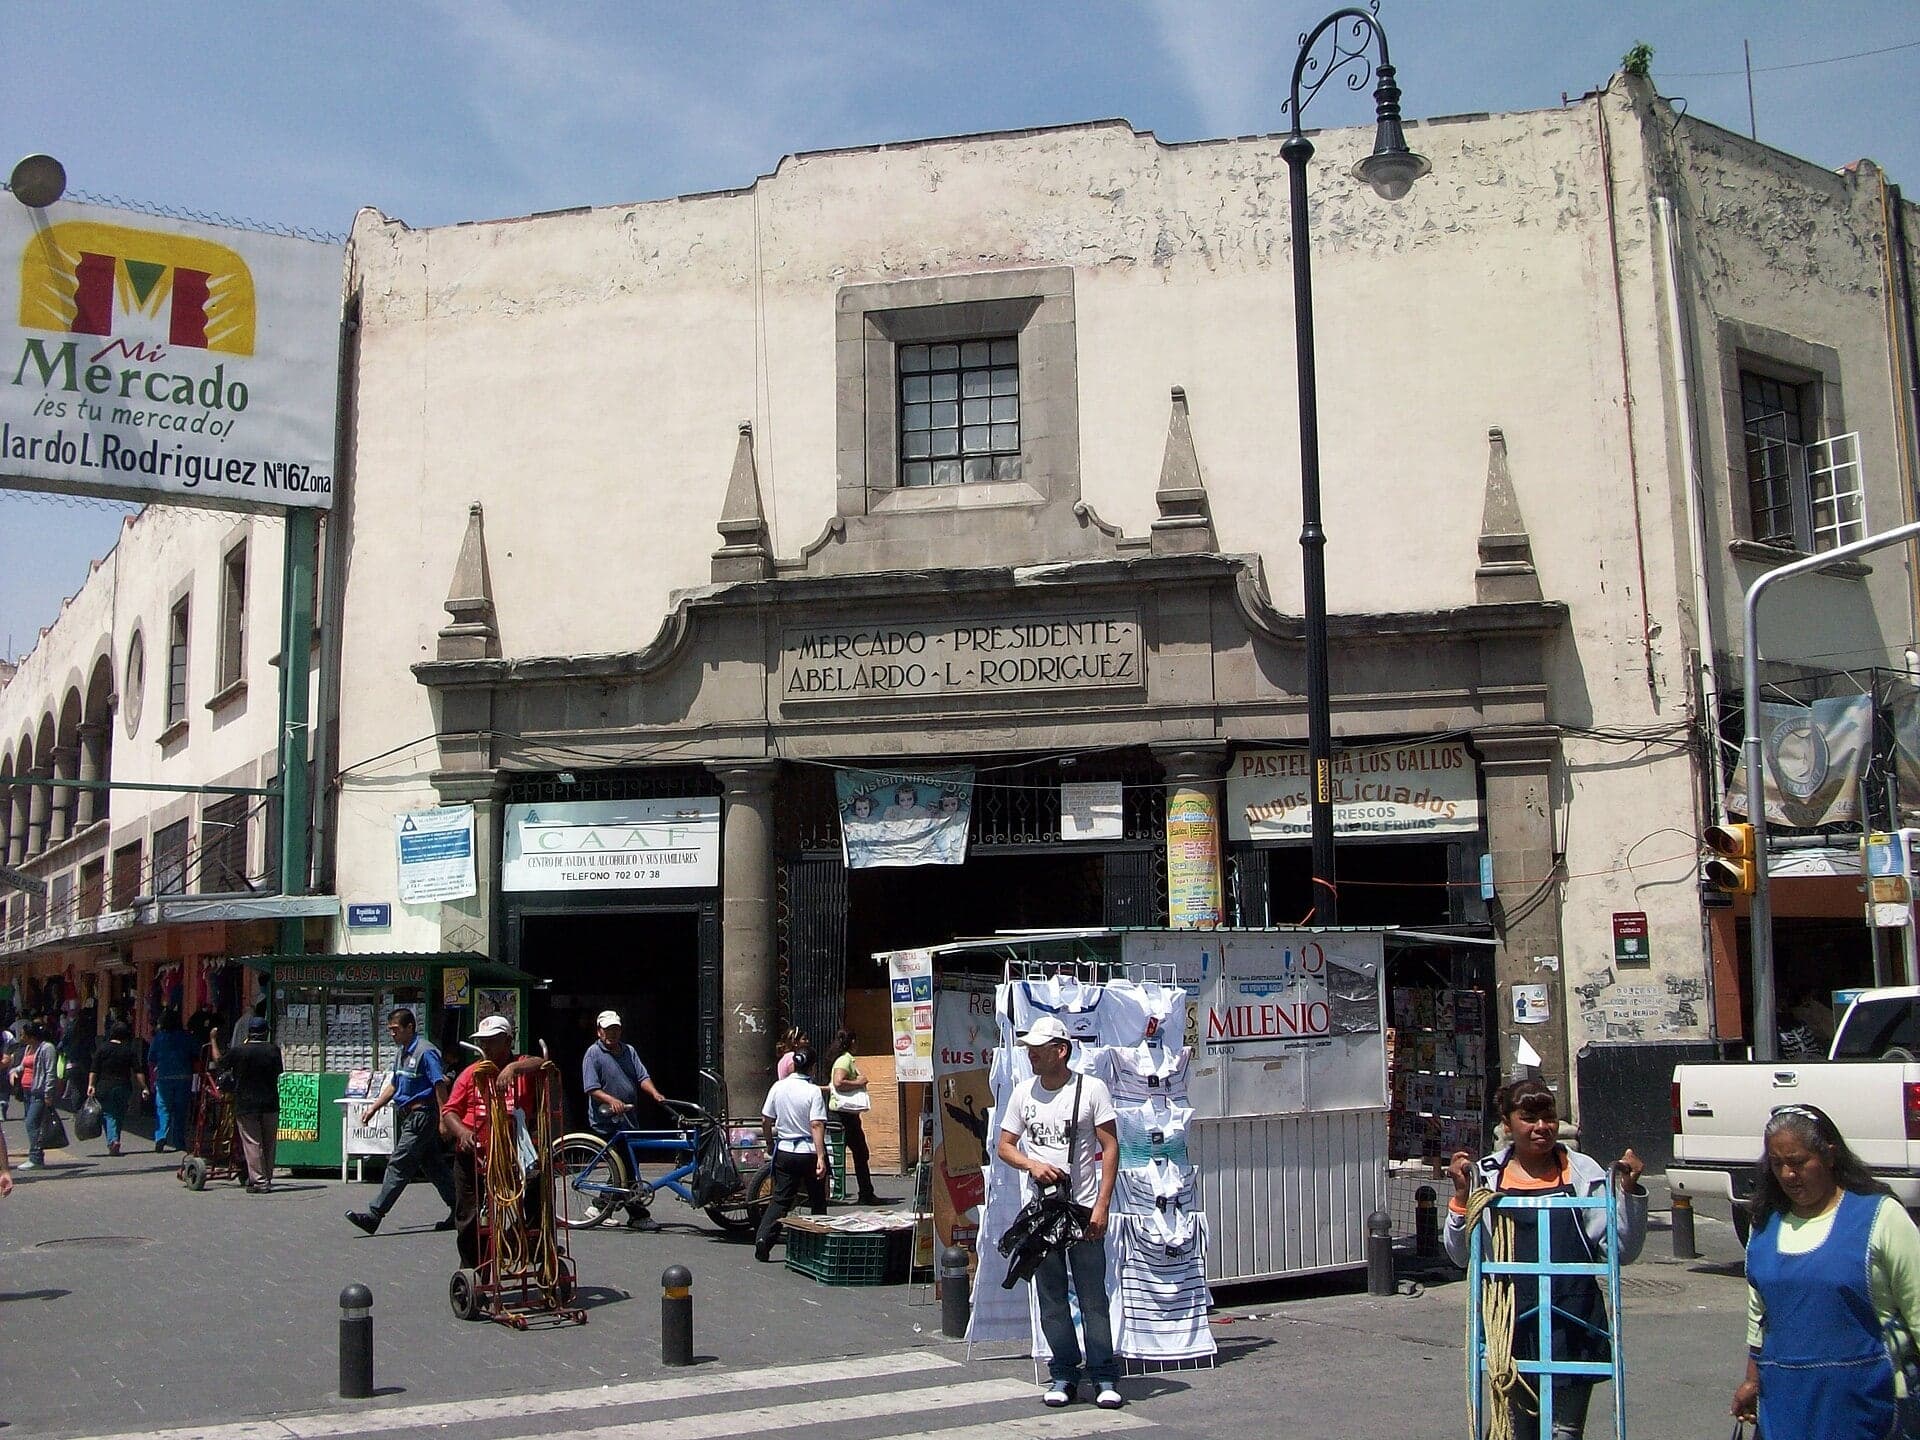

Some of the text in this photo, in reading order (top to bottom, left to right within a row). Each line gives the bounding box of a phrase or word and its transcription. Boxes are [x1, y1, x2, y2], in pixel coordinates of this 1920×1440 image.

[90, 338, 168, 363] Mi
[11, 338, 250, 413] Mercado
[77, 398, 102, 422] tu
[111, 407, 235, 443] mercado!
[102, 433, 257, 487] Rodriguez
[799, 619, 1121, 660] MERCADO PRESIDENTE
[788, 652, 1134, 692] ABELARDO L RODRIGUEZ
[1360, 751, 1391, 773] LOS
[1397, 747, 1463, 771] GALLOS
[1244, 790, 1308, 826] Jugos
[1384, 818, 1437, 832] FRUTAS
[528, 856, 554, 867] CENTRO
[555, 856, 563, 867] DE
[646, 853, 659, 865] SUS
[660, 852, 698, 864] FAMILIARES
[561, 870, 660, 881] TELEFONO 702 07 38
[274, 964, 336, 983] BILLETES
[345, 964, 380, 982] CASA
[969, 992, 996, 1016] Re
[1206, 1001, 1331, 1040] MILENIO
[940, 1048, 975, 1065] tus
[1207, 1045, 1236, 1057] DIARIO
[1024, 1104, 1037, 1121] 23
